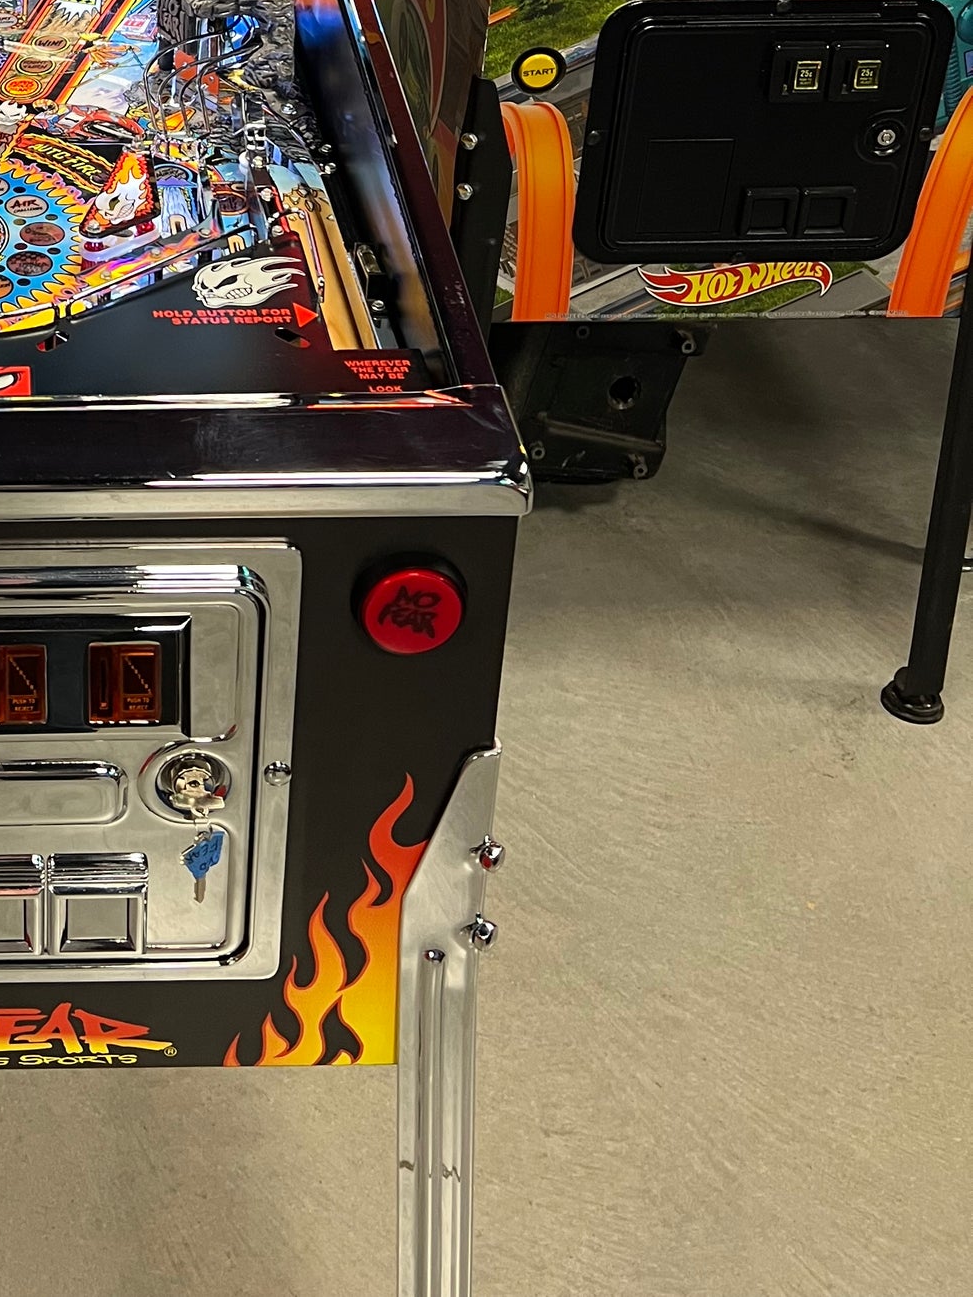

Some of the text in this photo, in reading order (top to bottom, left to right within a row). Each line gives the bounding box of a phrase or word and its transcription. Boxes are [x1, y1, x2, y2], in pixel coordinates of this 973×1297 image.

[522, 66, 556, 77] START
[686, 272, 740, 303] HOT
[152, 308, 291, 319] HOLD BUTTON FOR
[171, 315, 293, 326] STATUS REPORT
[343, 359, 411, 367] WHEREVER
[350, 366, 375, 374] THE
[388, 372, 405, 380] BE
[358, 385, 403, 393] LOOK
[17, 1054, 139, 1065] SPORTS
